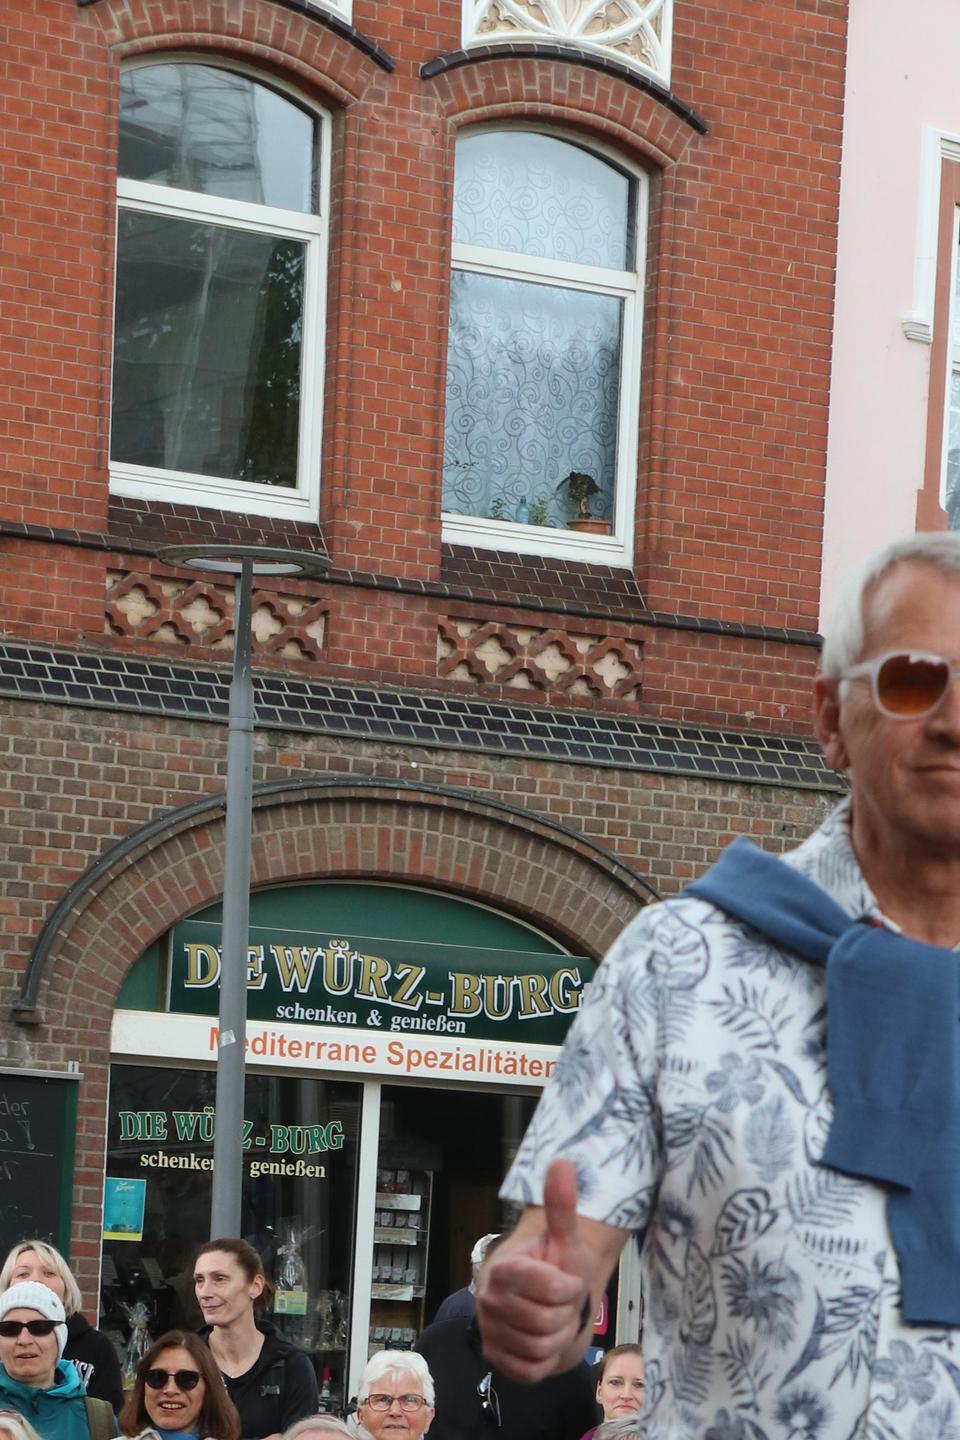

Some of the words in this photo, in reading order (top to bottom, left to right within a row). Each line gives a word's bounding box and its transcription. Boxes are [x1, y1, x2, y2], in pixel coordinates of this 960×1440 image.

[184, 943, 267, 990] DE
[276, 1003, 358, 1025] schenken
[366, 1009, 382, 1027] &
[390, 1014, 466, 1034] genießen
[118, 1111, 168, 1141] DIE
[172, 1106, 345, 1155] WÜZ-BURG
[140, 1151, 214, 1171] schenke
[249, 1159, 326, 1178] genießen
